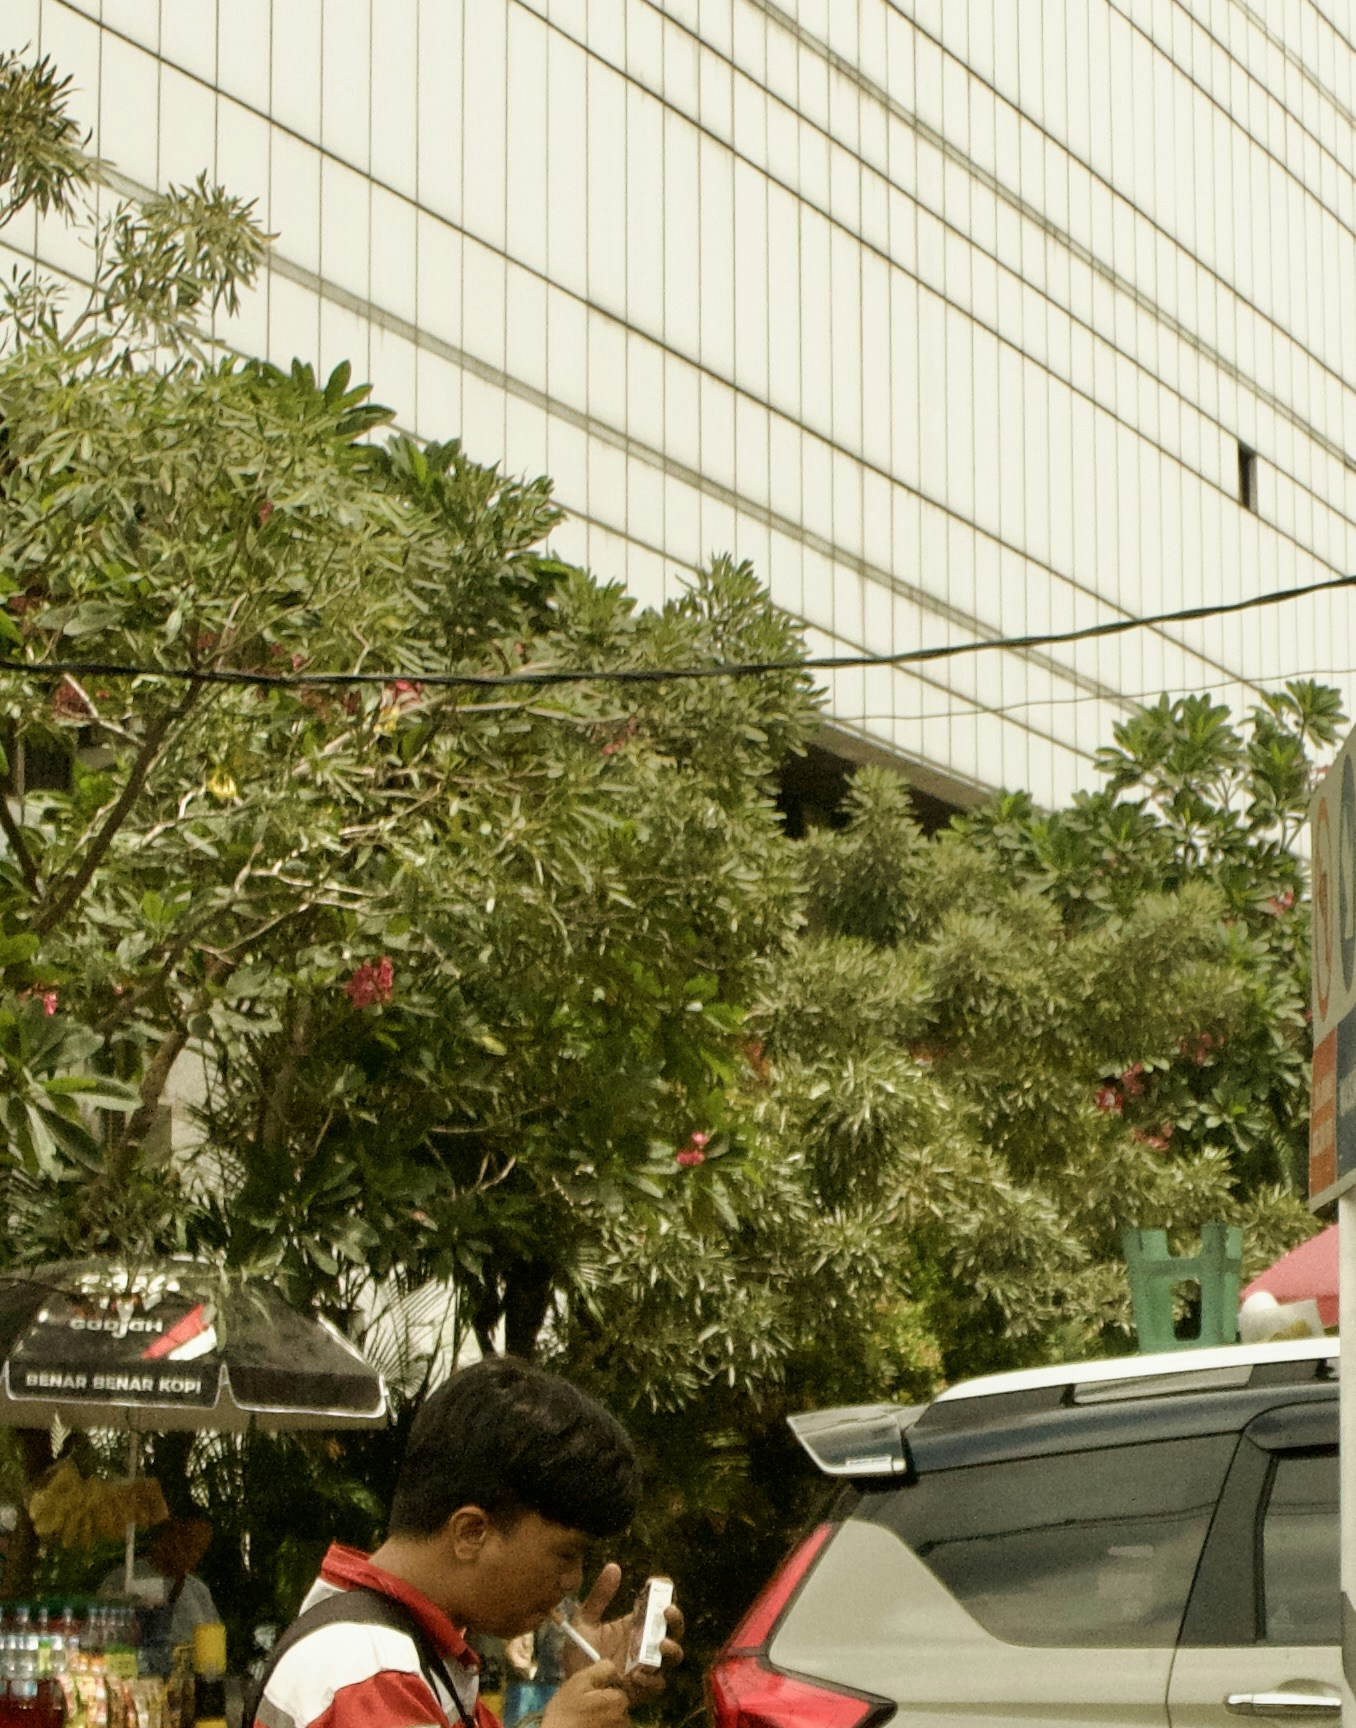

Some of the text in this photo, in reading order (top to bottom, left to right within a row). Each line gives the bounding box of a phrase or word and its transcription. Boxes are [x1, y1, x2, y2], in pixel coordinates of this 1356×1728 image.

[25, 1373, 202, 1395] BENAR BENAR KOPI
